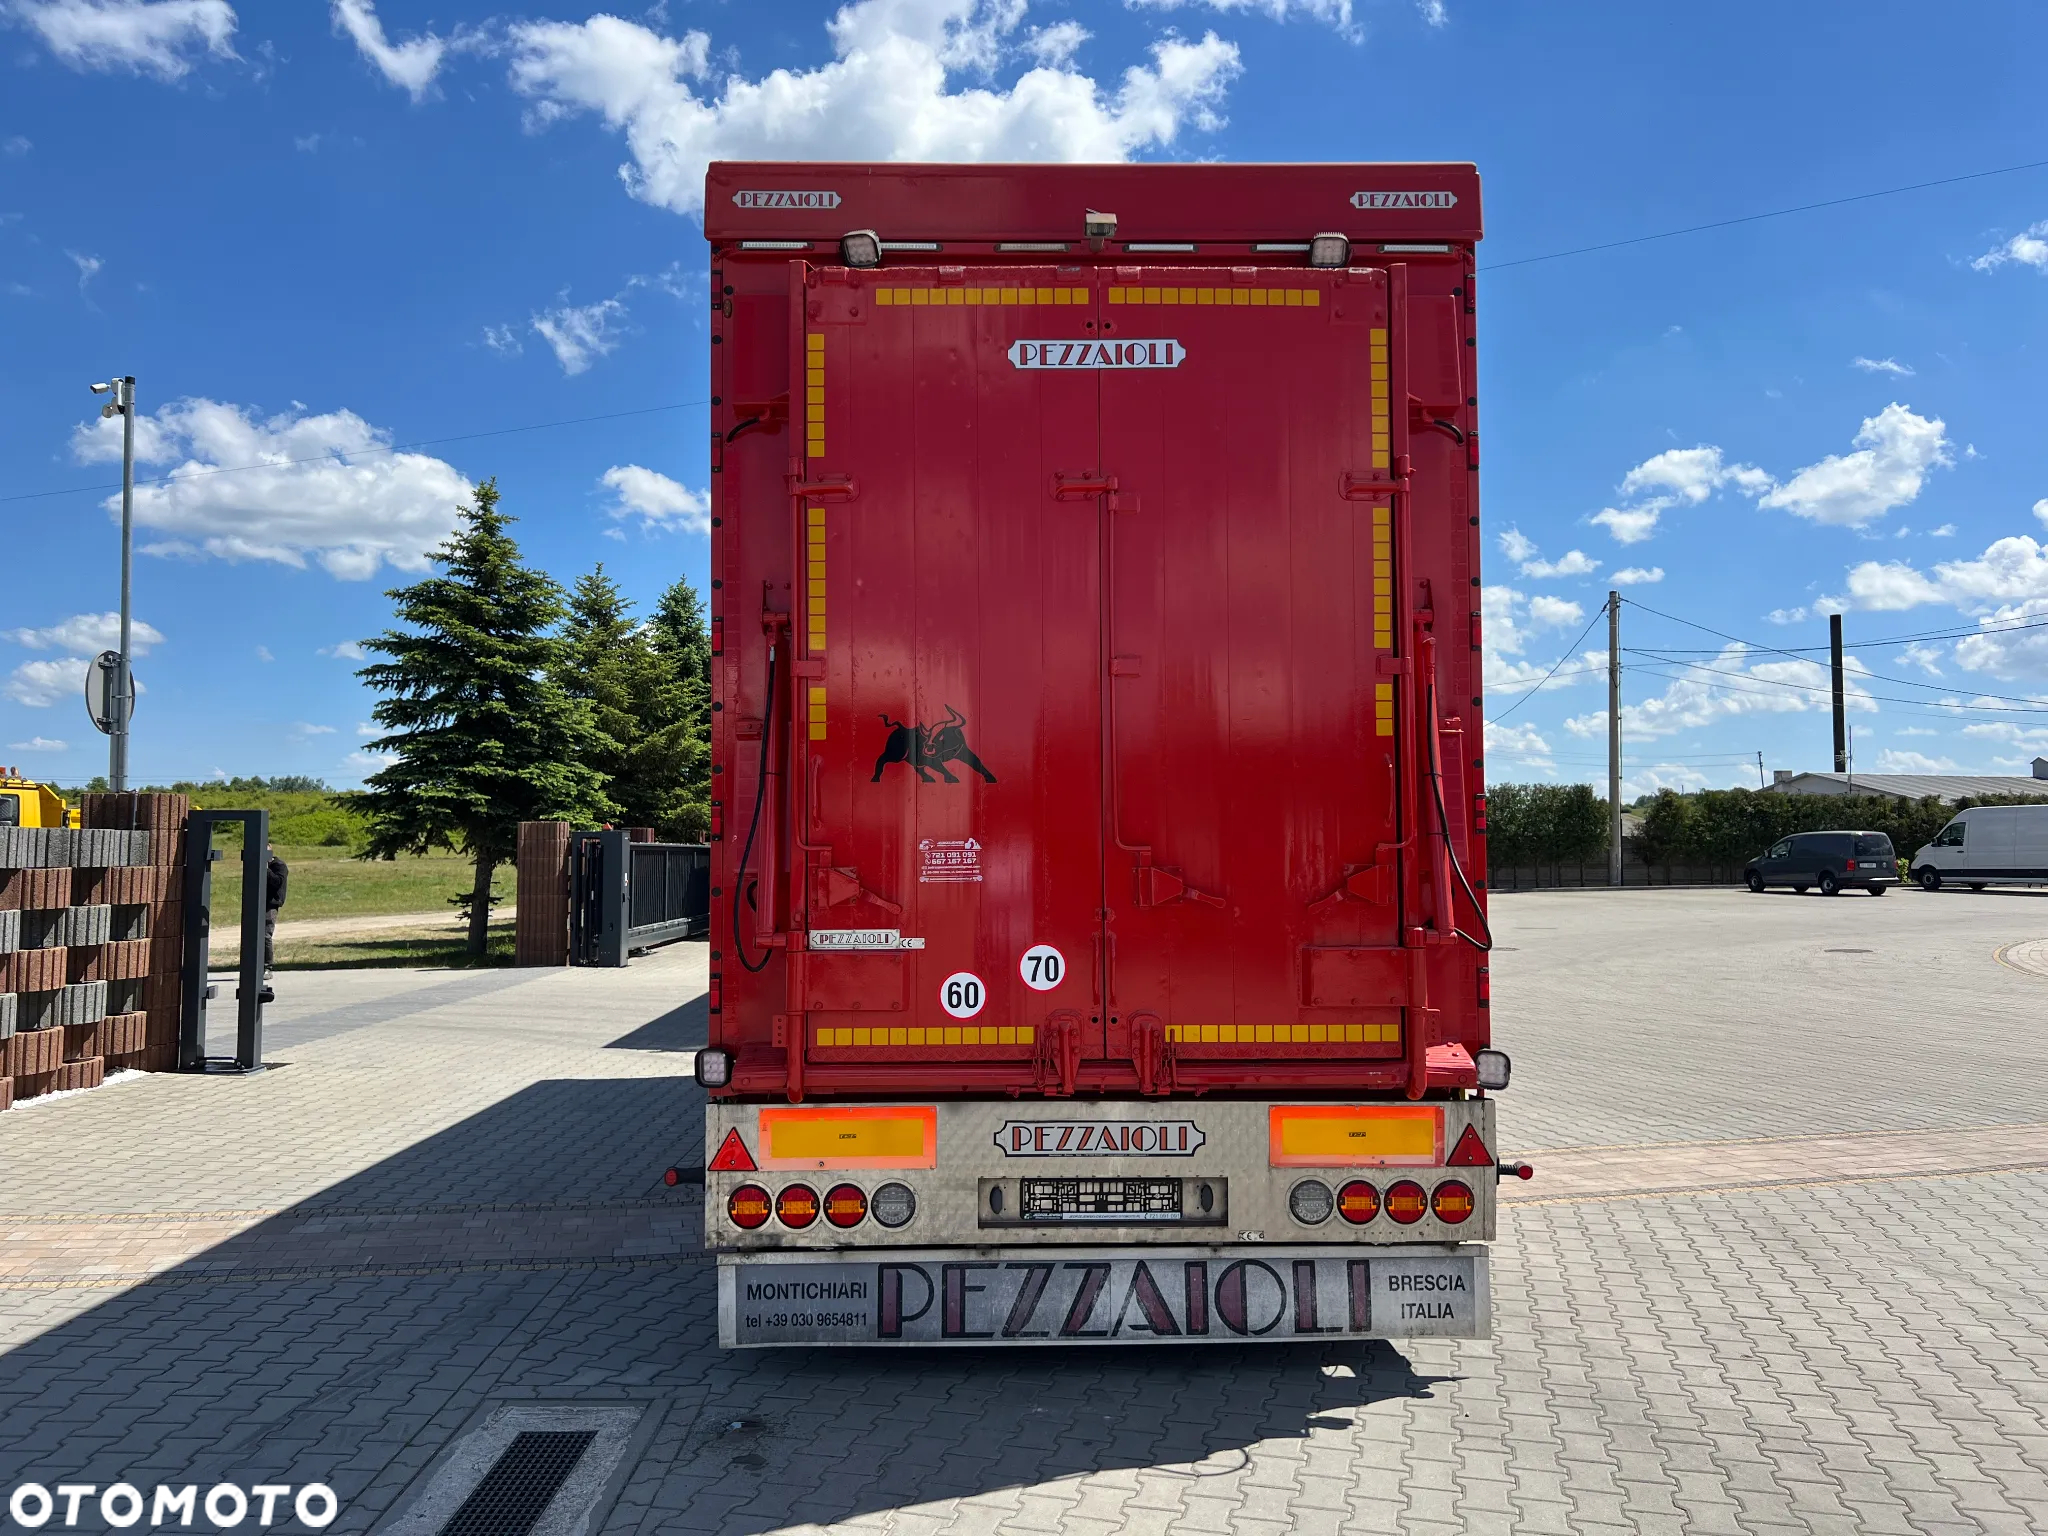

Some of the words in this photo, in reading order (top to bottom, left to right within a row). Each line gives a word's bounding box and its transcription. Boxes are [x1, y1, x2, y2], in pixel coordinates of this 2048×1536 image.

[741, 193, 833, 207] PEZZAIOLI
[1358, 193, 1449, 207] PEZZAIOLI
[1019, 343, 1173, 365] PEZZAIOLI
[819, 933, 889, 944] PEZZAIOLI
[1027, 955, 1059, 982] 70
[947, 981, 979, 1009] 60
[1012, 1125, 1187, 1152] PEZZAIOLI
[746, 1282, 867, 1301] MONTICHIARI
[1388, 1274, 1466, 1292] BRESCIA
[877, 1259, 1372, 1339] PEZZAIOLI
[1401, 1302, 1455, 1319] ITALIA
[746, 1313, 761, 1328] tel
[765, 1313, 788, 1327] +39
[791, 1312, 814, 1327] 030
[816, 1312, 867, 1327] 9654811
